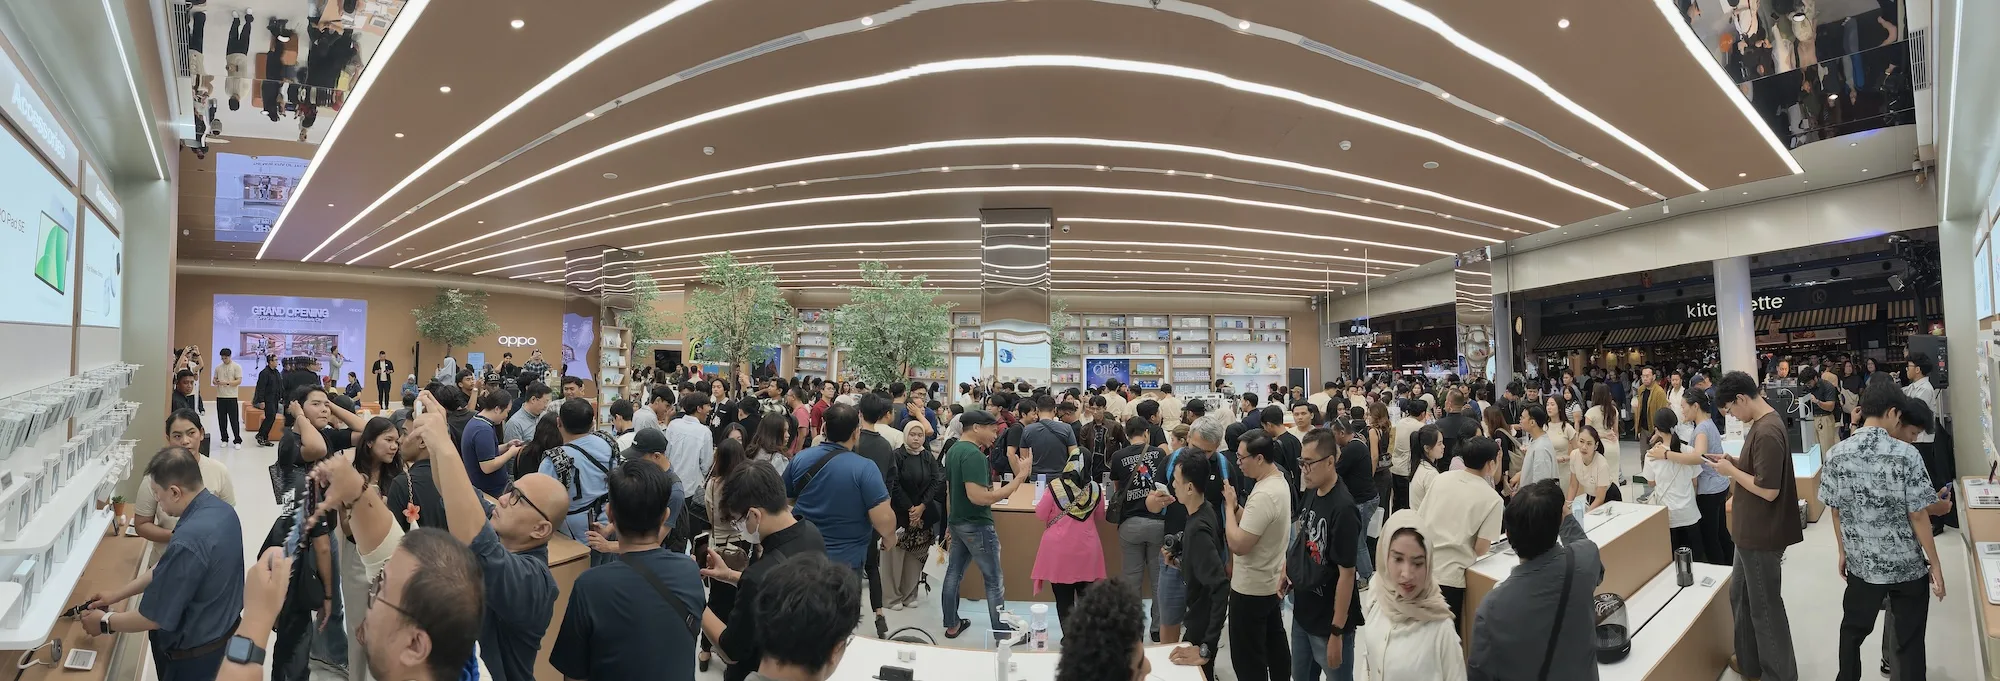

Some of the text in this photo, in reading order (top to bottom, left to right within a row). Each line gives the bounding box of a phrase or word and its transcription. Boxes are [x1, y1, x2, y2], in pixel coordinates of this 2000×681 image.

[12, 82, 66, 160] Accessories
[7, 212, 17, 229] Pad
[18, 219, 25, 234] SE
[251, 305, 286, 317] GRAND
[286, 307, 330, 319] OPENING
[1686, 295, 1784, 319] kitcette
[1092, 363, 1120, 376] Ollie
